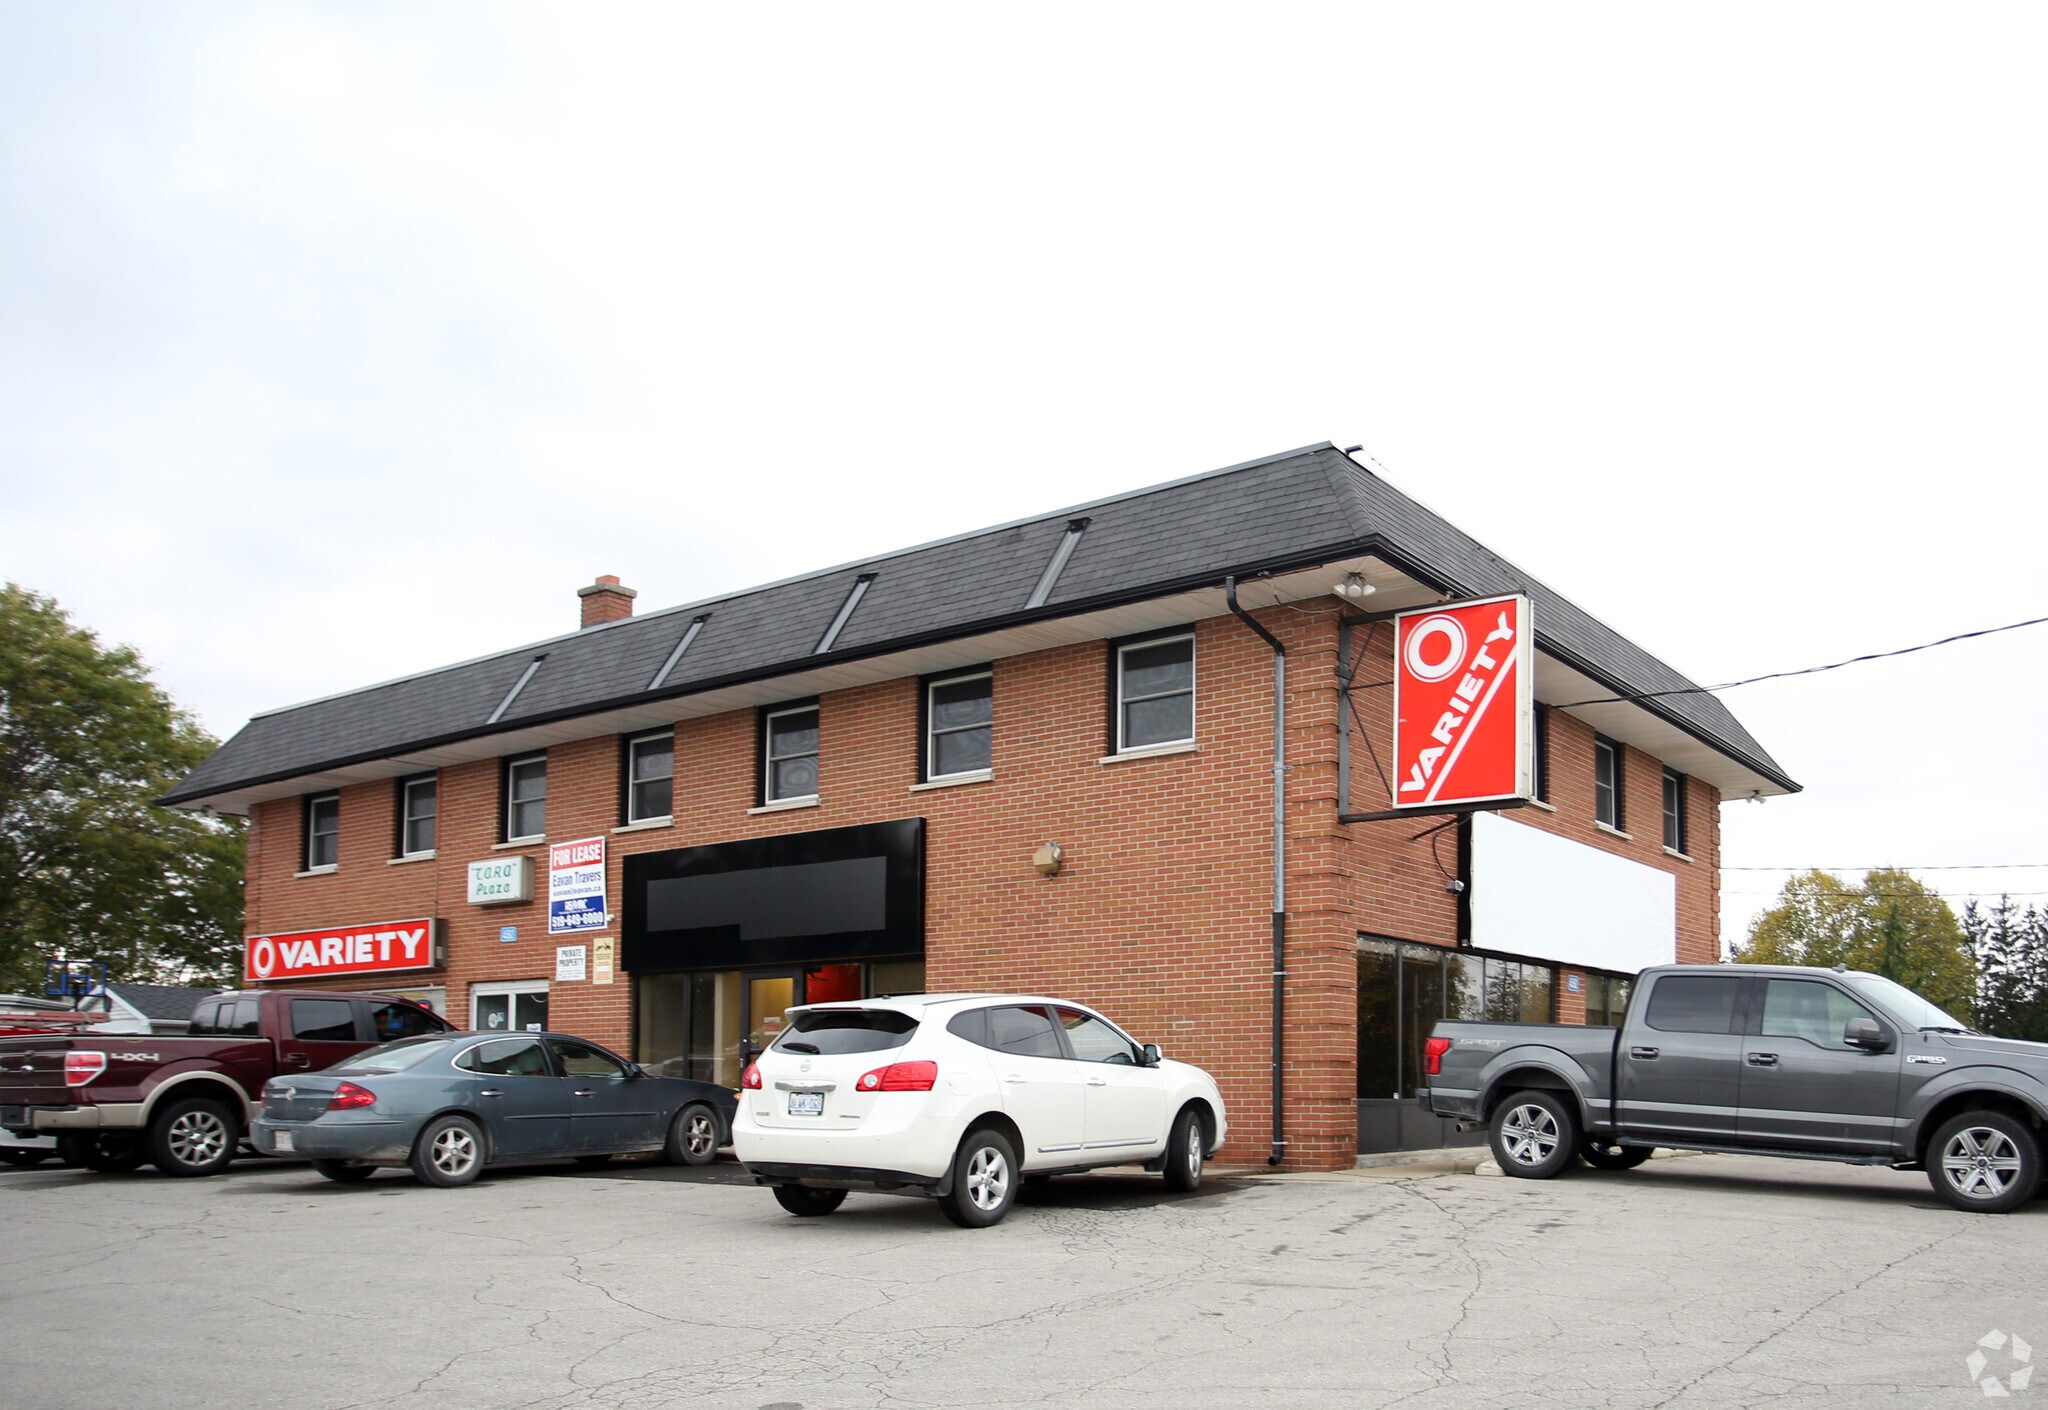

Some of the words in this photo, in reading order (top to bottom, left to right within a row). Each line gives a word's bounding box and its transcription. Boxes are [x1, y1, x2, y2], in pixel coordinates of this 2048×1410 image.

[1399, 611, 1514, 792] VARIETY
[553, 849, 571, 867] FOR
[572, 843, 601, 864] LEASE
[574, 871, 602, 884] Travers
[279, 928, 426, 969] VARIETY
[561, 949, 582, 957] PRIVATE
[559, 958, 584, 967] PROPERTY
